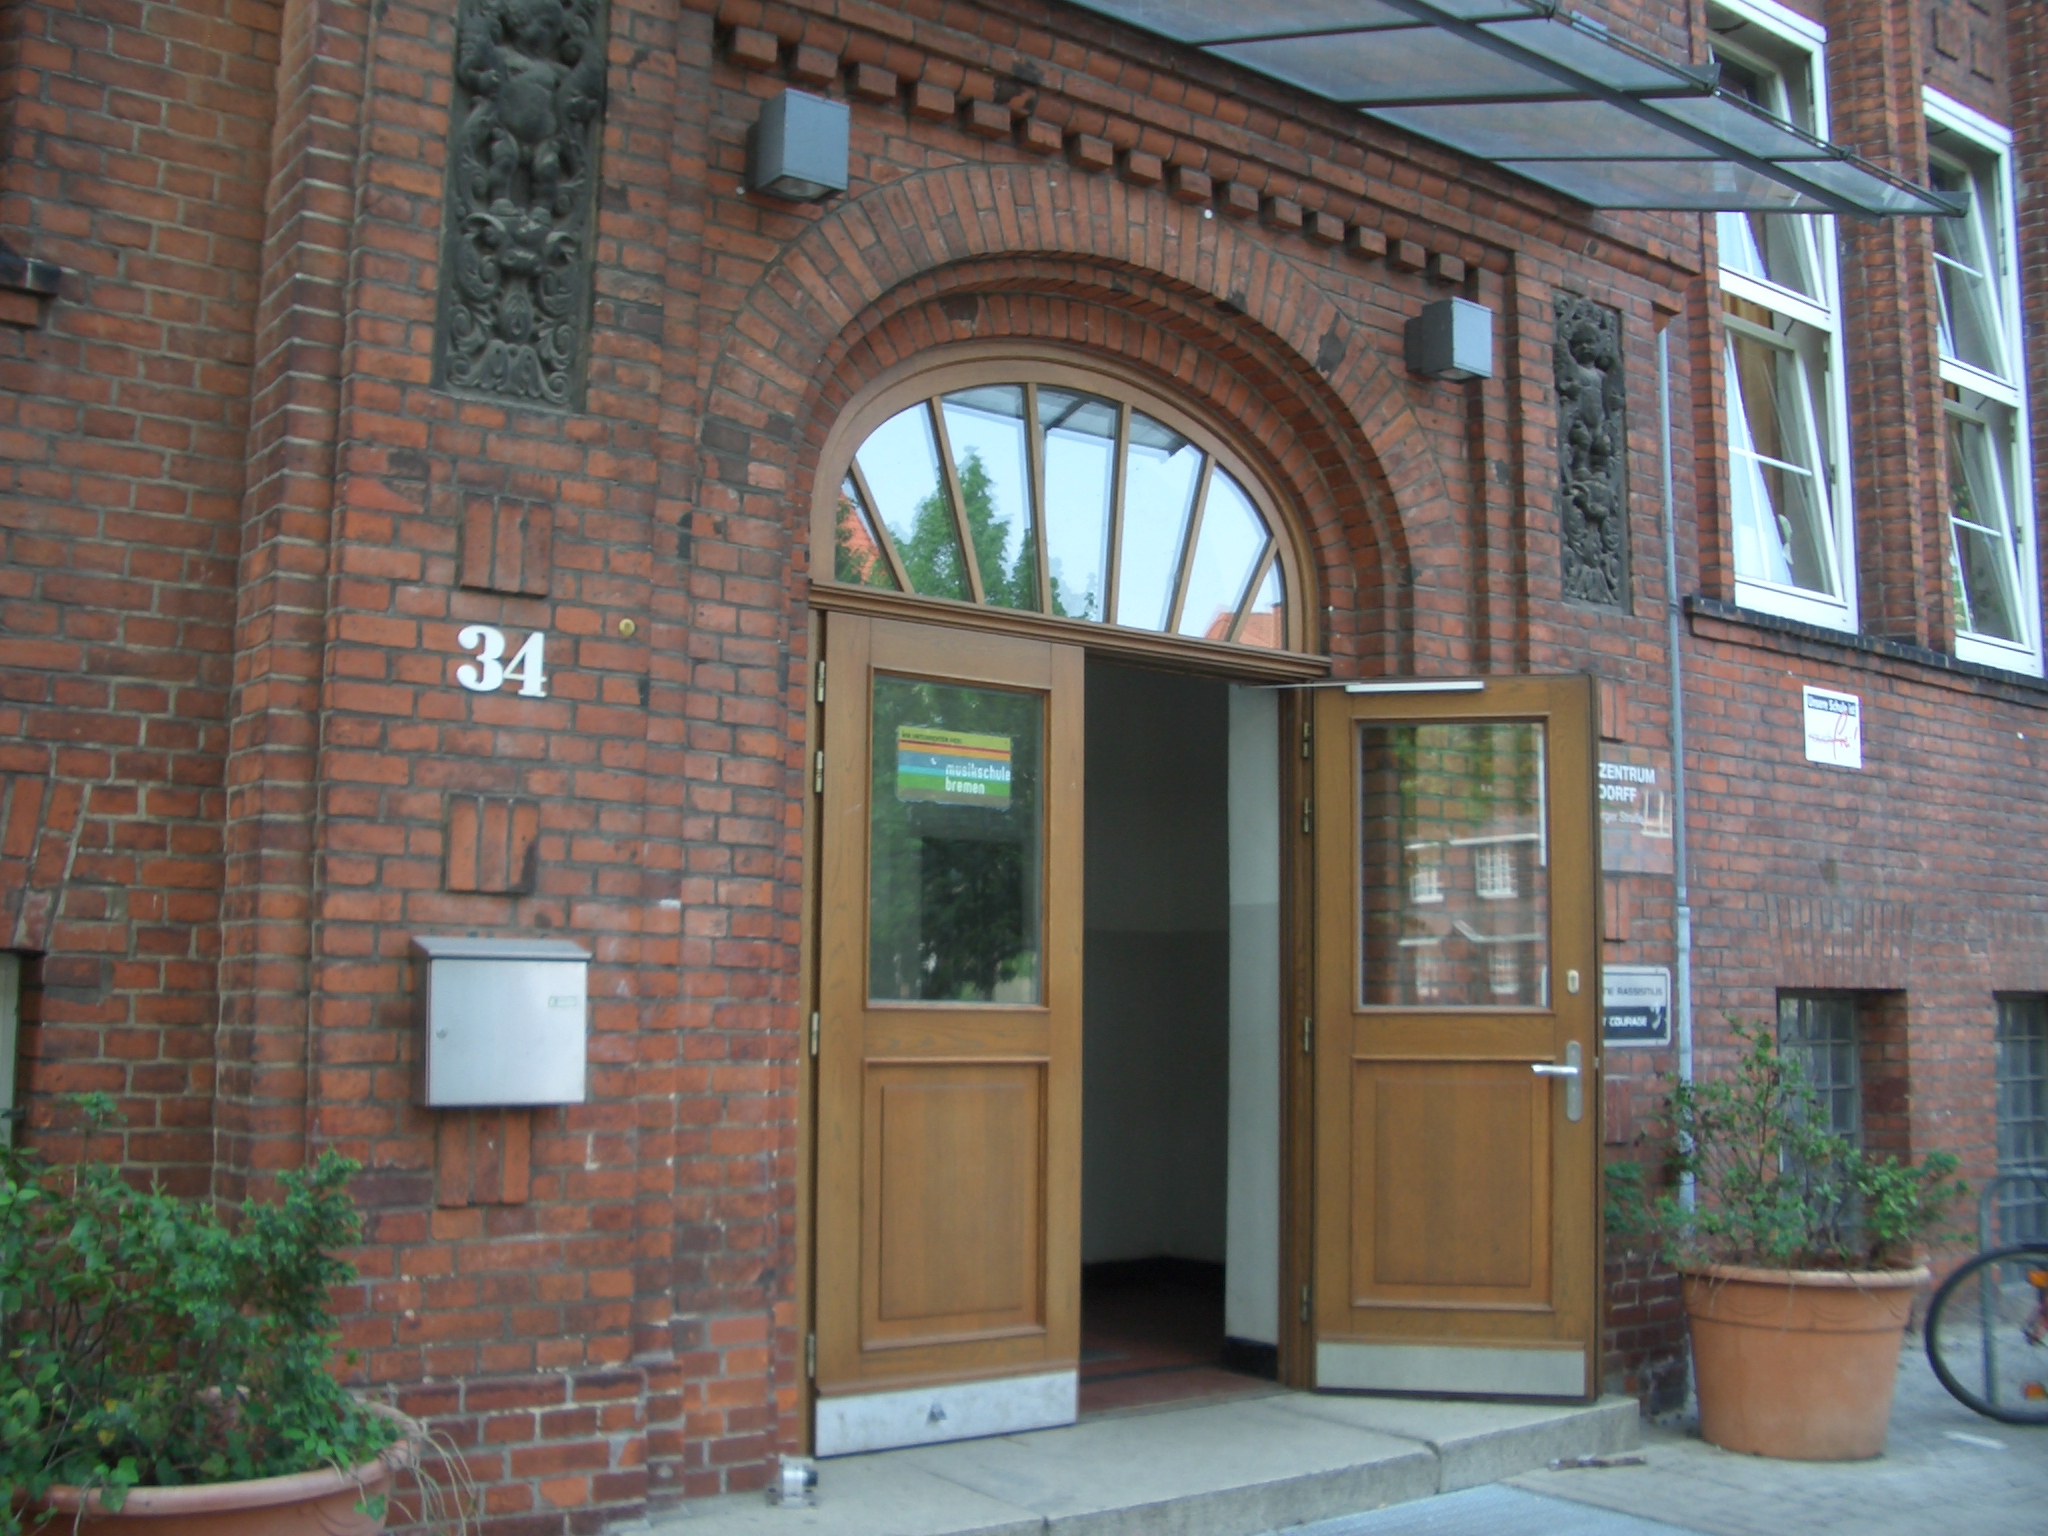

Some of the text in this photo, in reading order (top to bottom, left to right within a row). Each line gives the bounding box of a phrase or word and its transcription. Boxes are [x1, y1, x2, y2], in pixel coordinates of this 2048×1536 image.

[456, 624, 548, 698] 34
[945, 762, 1011, 781] musikschule
[1598, 762, 1656, 784] ZENTRUM
[945, 776, 985, 794] bremen
